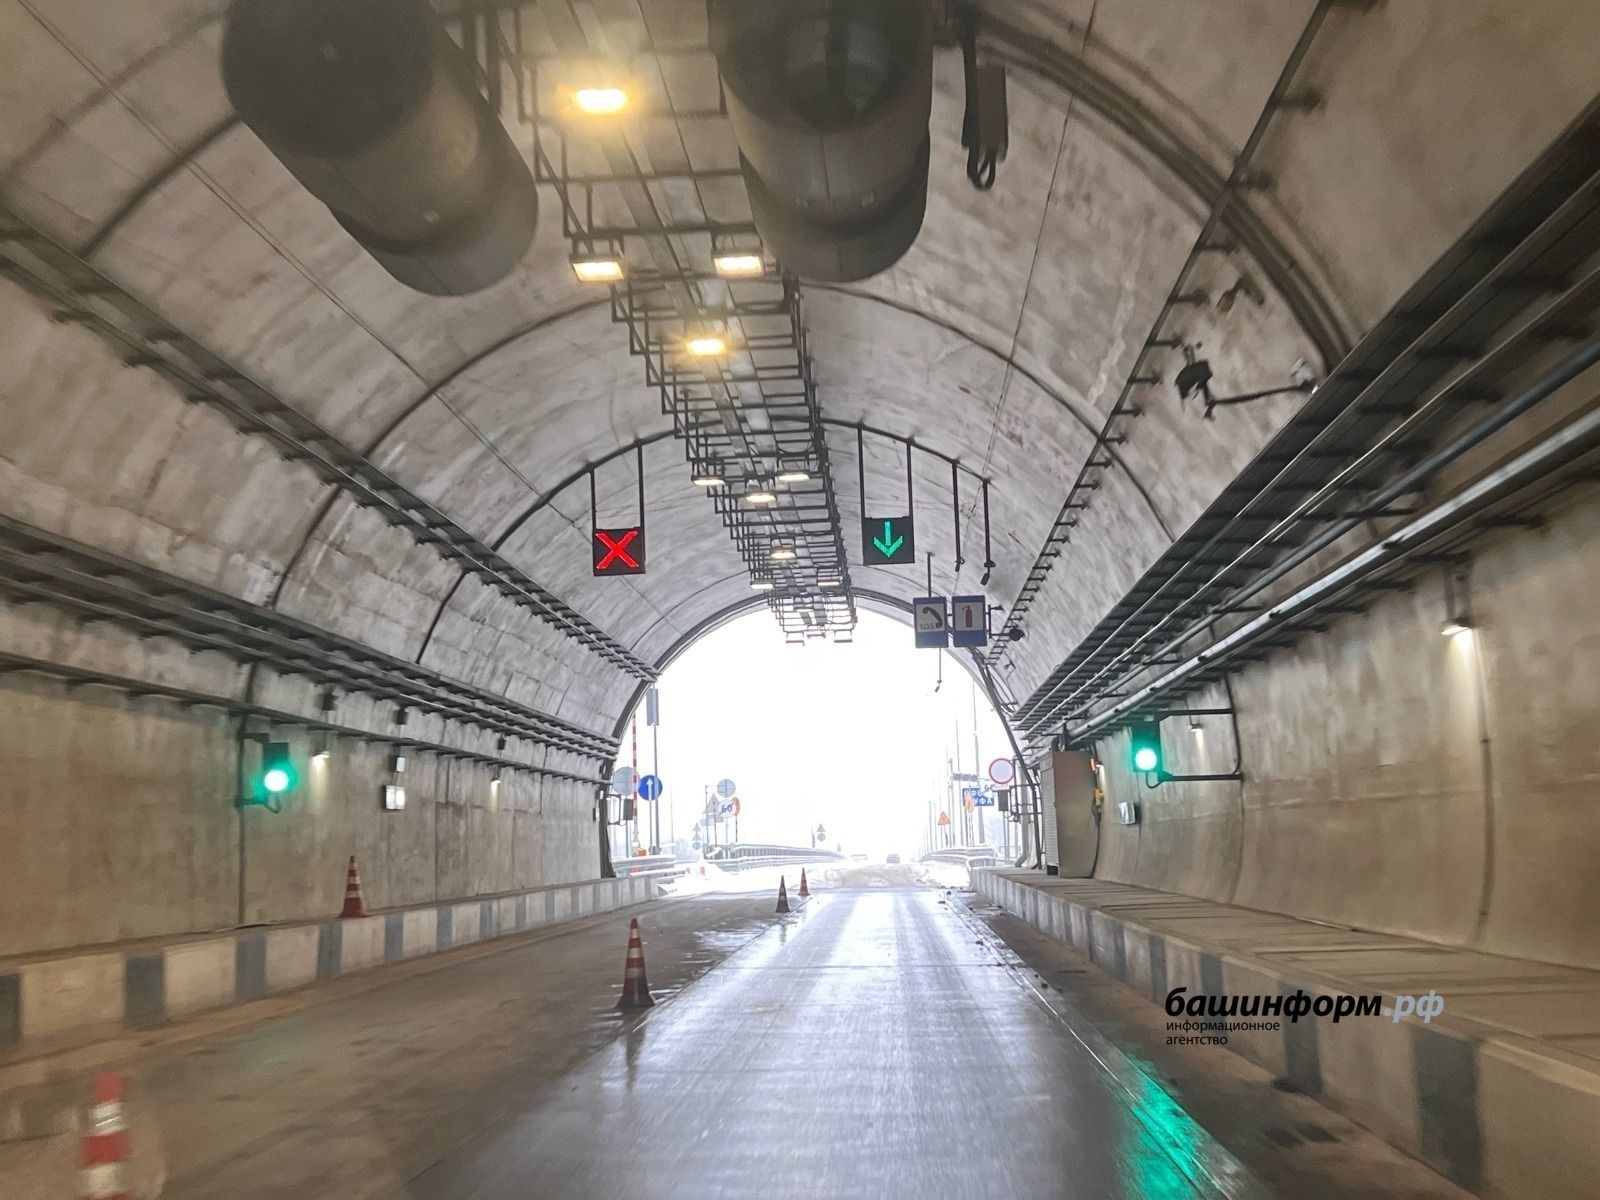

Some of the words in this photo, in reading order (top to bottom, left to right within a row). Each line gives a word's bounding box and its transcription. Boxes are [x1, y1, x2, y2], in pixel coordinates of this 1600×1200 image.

[919, 622, 935, 630] SOS
[973, 797, 993, 805] УФА
[721, 804, 733, 813] 60
